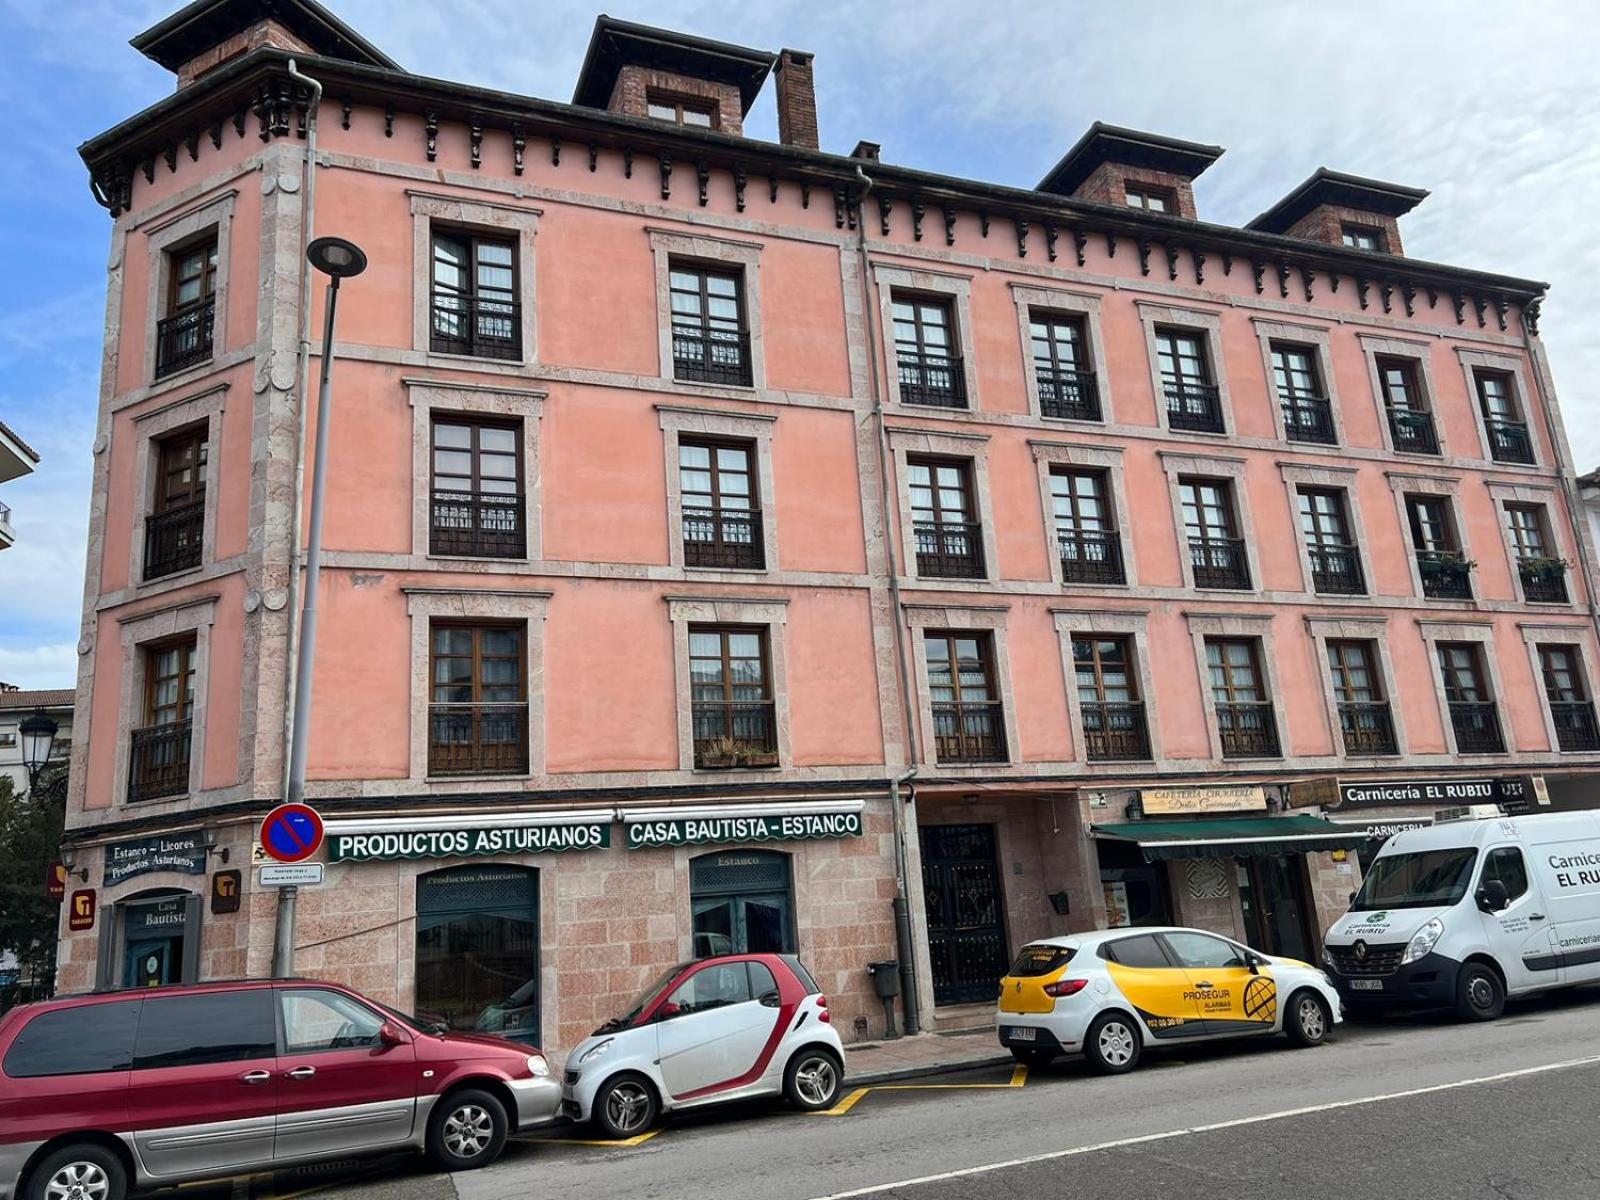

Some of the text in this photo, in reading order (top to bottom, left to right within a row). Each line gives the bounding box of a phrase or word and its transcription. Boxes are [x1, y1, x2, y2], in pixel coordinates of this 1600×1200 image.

[1347, 785, 1420, 801] Carnicería
[1426, 786, 1444, 798] EL
[1446, 784, 1492, 798] RUBIU
[629, 823, 680, 843] CASA
[685, 818, 768, 840] BAUTISTA
[782, 814, 858, 834] ESTANCO
[114, 847, 147, 859] Estanco
[160, 840, 194, 852] Licores
[339, 825, 602, 856] PRODUCTOS ASTURIANOS
[112, 855, 194, 879] Productos Asturianos
[718, 857, 760, 867] Estanco
[427, 875, 475, 885] Productos
[1556, 869, 1600, 887] EL RU
[1183, 989, 1231, 1001] PROSEGUR
